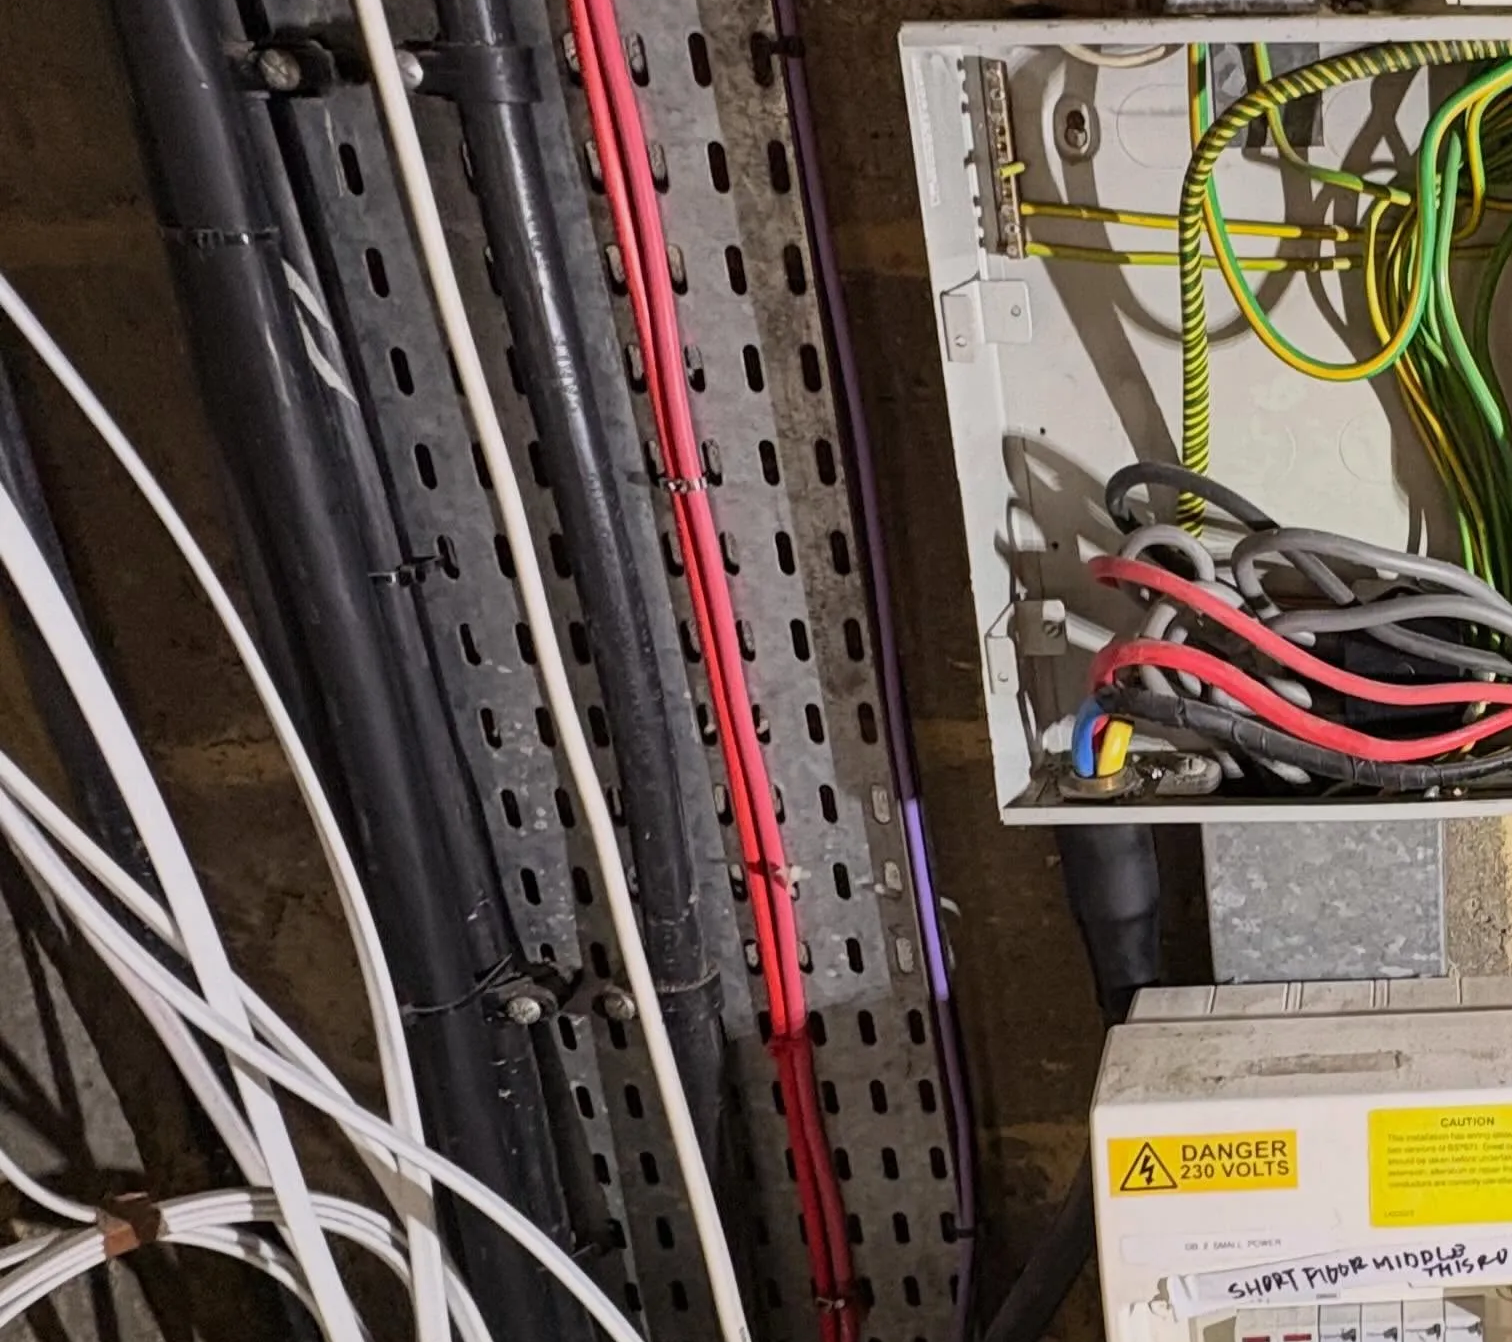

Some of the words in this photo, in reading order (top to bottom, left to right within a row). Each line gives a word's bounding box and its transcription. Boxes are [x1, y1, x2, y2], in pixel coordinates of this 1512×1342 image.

[1440, 1117, 1495, 1128] CAUTION
[1181, 1140, 1288, 1162] DANGER
[1180, 1163, 1215, 1180] 230
[1225, 1159, 1290, 1178] VOLTS
[1247, 1239, 1282, 1248] POWER
[1422, 1259, 1474, 1278] THIS
